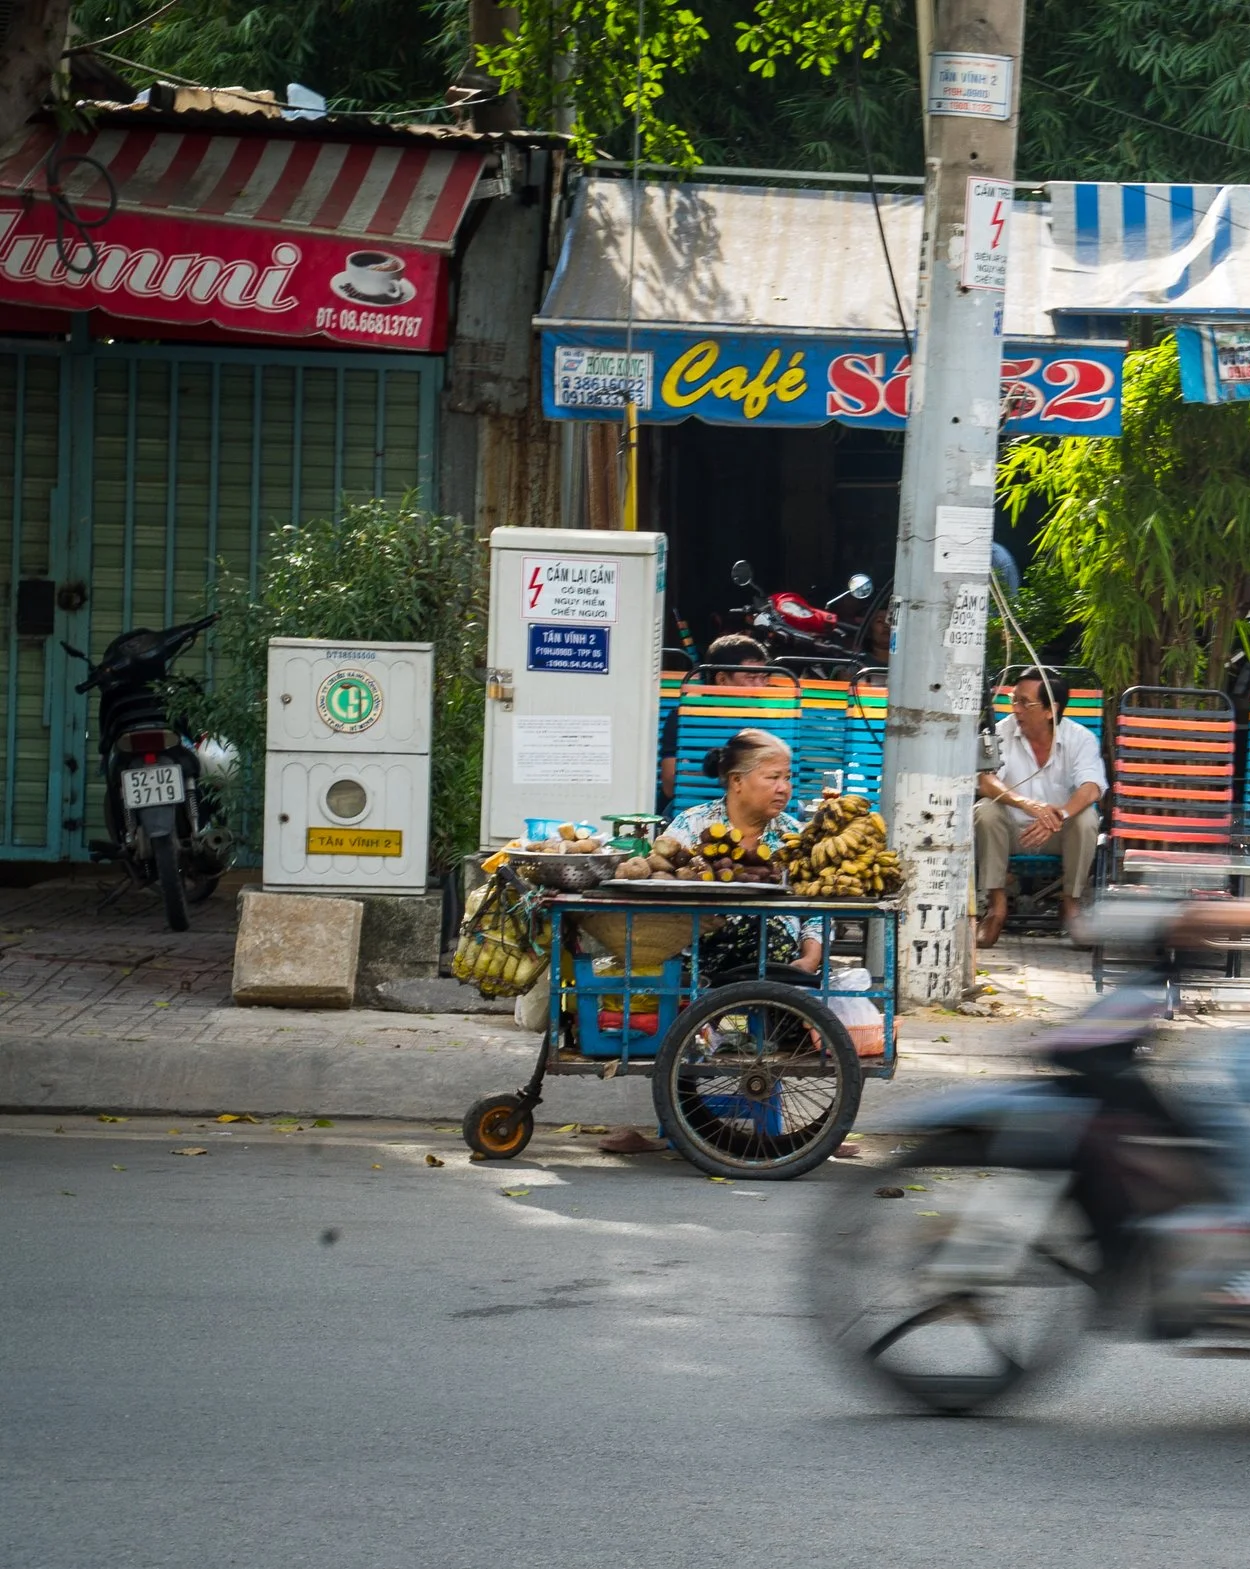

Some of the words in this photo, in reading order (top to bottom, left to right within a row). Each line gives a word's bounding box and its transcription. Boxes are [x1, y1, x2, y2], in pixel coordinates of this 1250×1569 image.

[340, 309, 422, 338] 08.66813787
[661, 340, 807, 419] Café
[554, 597, 579, 606] NGUY
[952, 611, 976, 627] 90%
[588, 634, 597, 645] 2
[131, 768, 173, 788] 52-U2
[133, 785, 175, 804] 3719
[384, 839, 392, 848] 2
